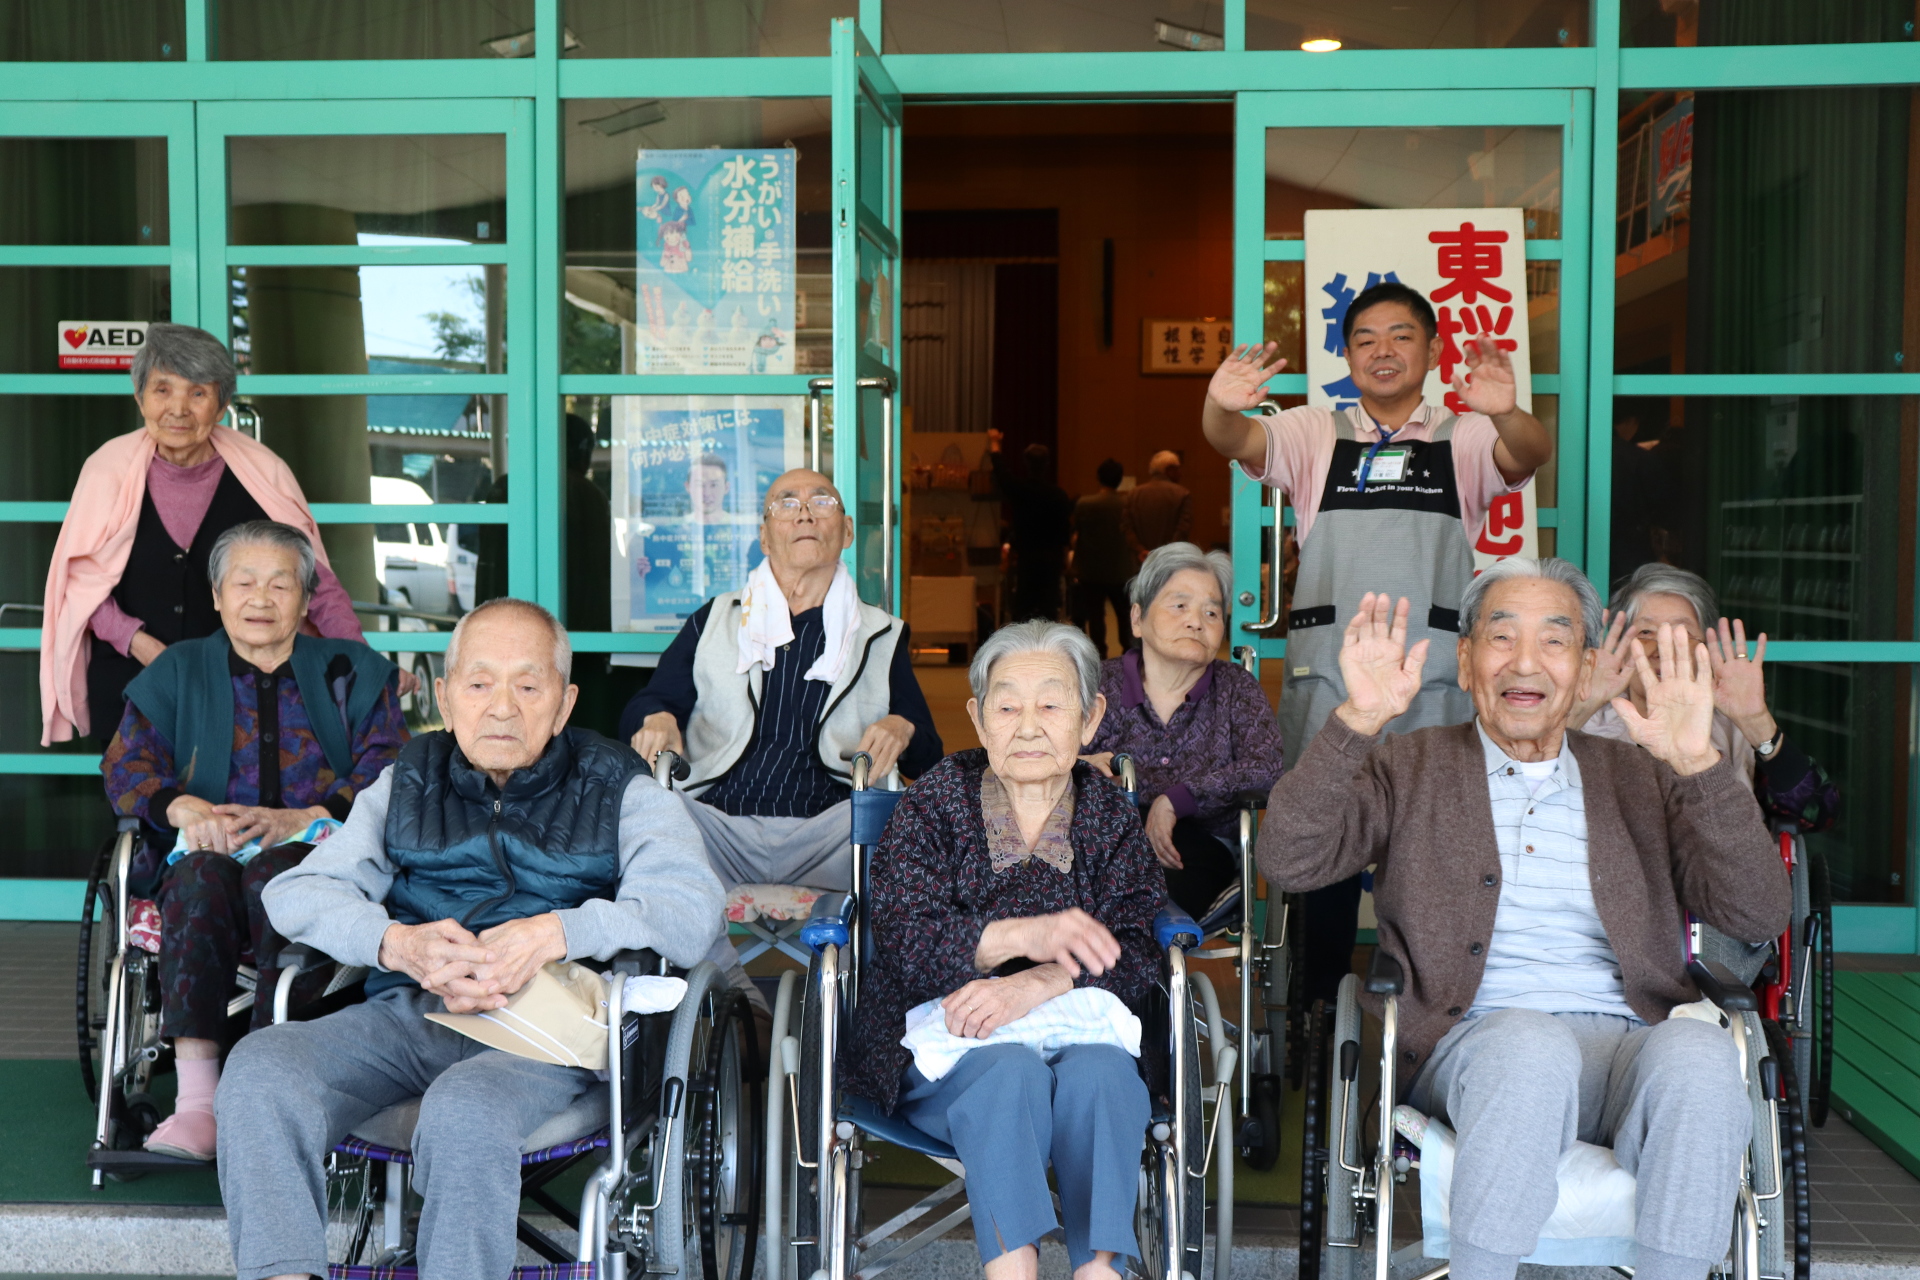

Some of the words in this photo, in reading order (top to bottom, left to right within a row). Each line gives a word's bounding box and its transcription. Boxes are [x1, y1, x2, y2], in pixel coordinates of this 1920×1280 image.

[721, 154, 756, 294] 水分補給
[88, 329, 145, 345] AED
[627, 409, 761, 449] 中症対策には、
[1336, 485, 1359, 494] Flow
[1415, 485, 1443, 494] kitchen
